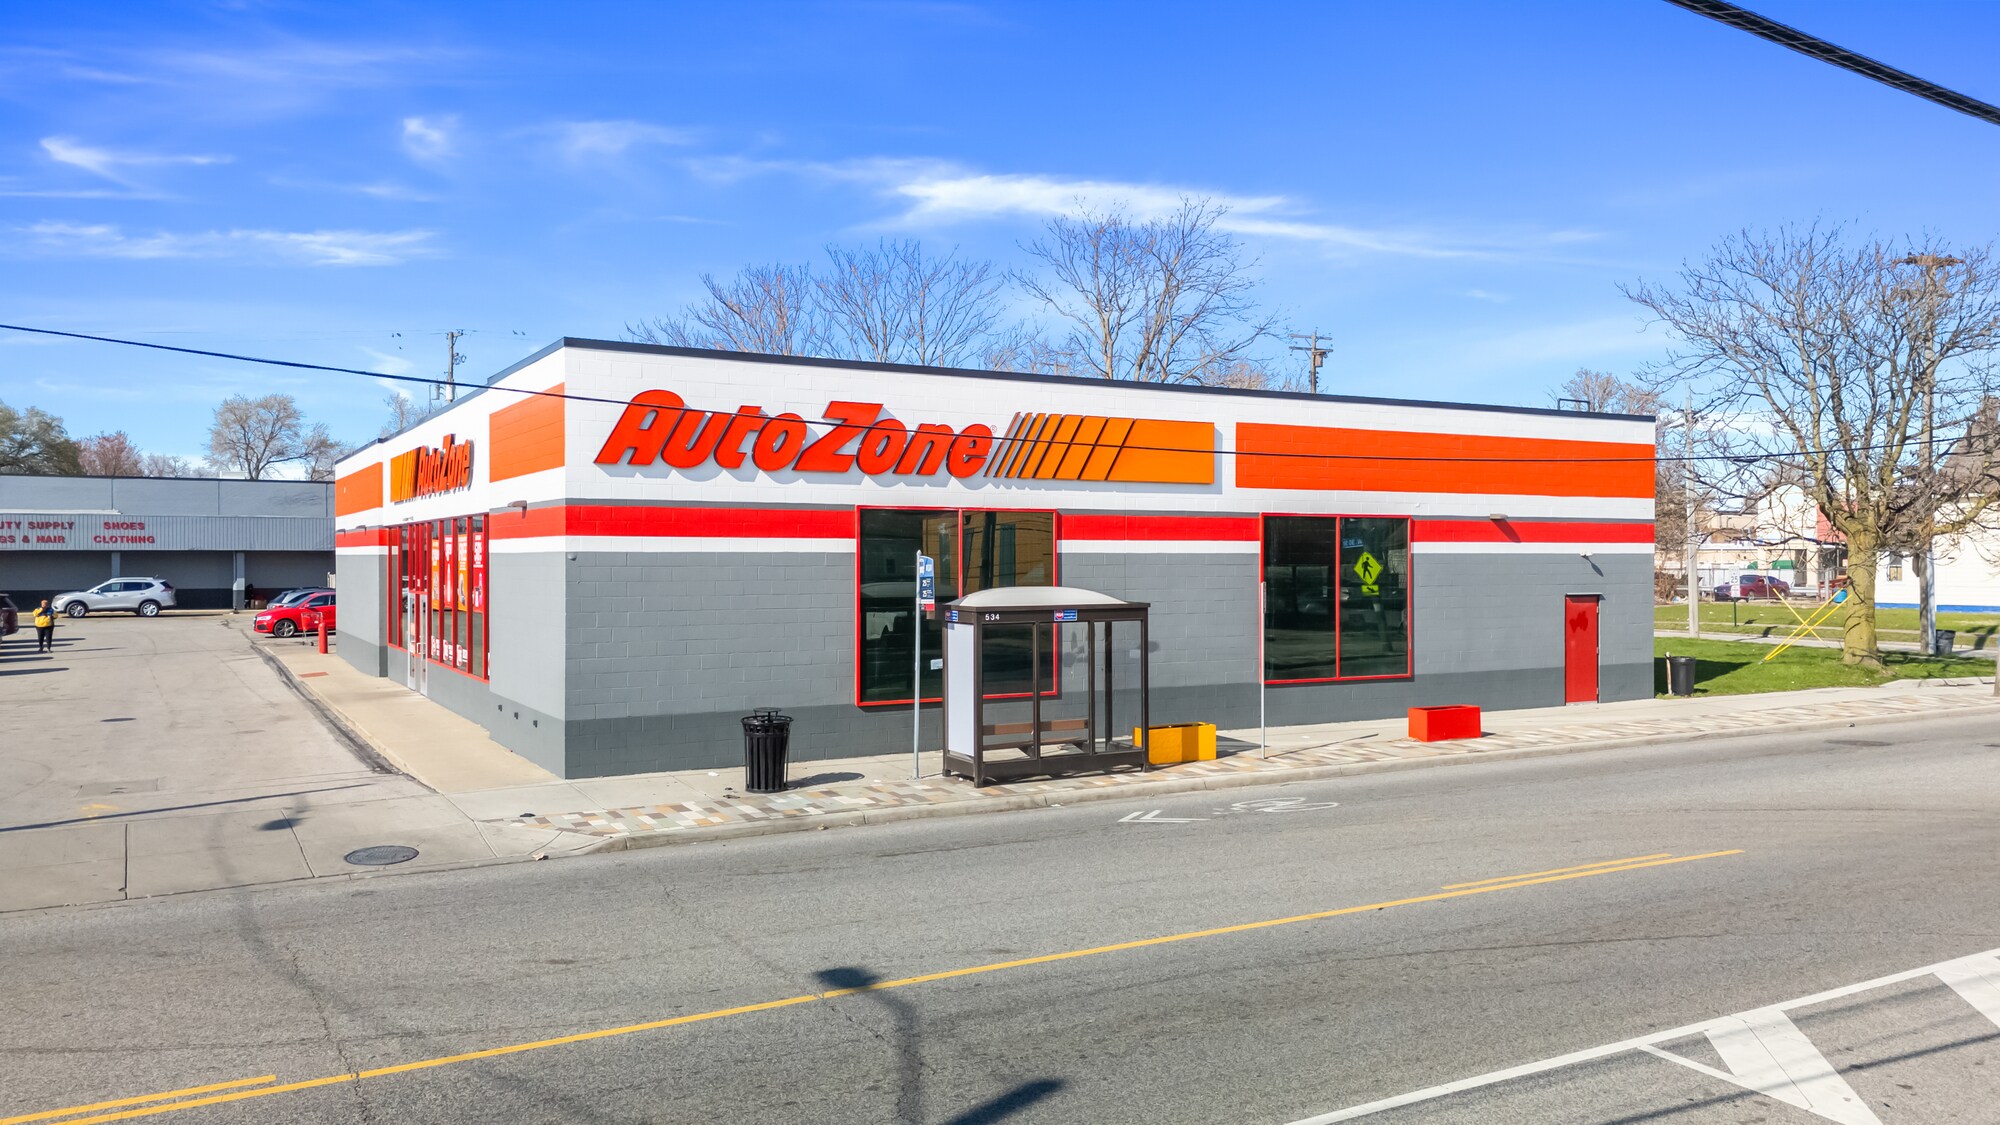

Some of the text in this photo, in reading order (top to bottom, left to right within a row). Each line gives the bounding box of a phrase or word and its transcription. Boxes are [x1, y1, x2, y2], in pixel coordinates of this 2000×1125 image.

[593, 389, 994, 479] AutoZone
[416, 433, 471, 497] AutoZone
[28, 521, 75, 530] SUPPLY
[104, 522, 145, 530] SHOES
[22, 535, 30, 544] &
[36, 535, 65, 544] HAIR
[93, 535, 155, 544] CLOTHING
[1731, 575, 1738, 583] 25
[985, 613, 1000, 621] 534
